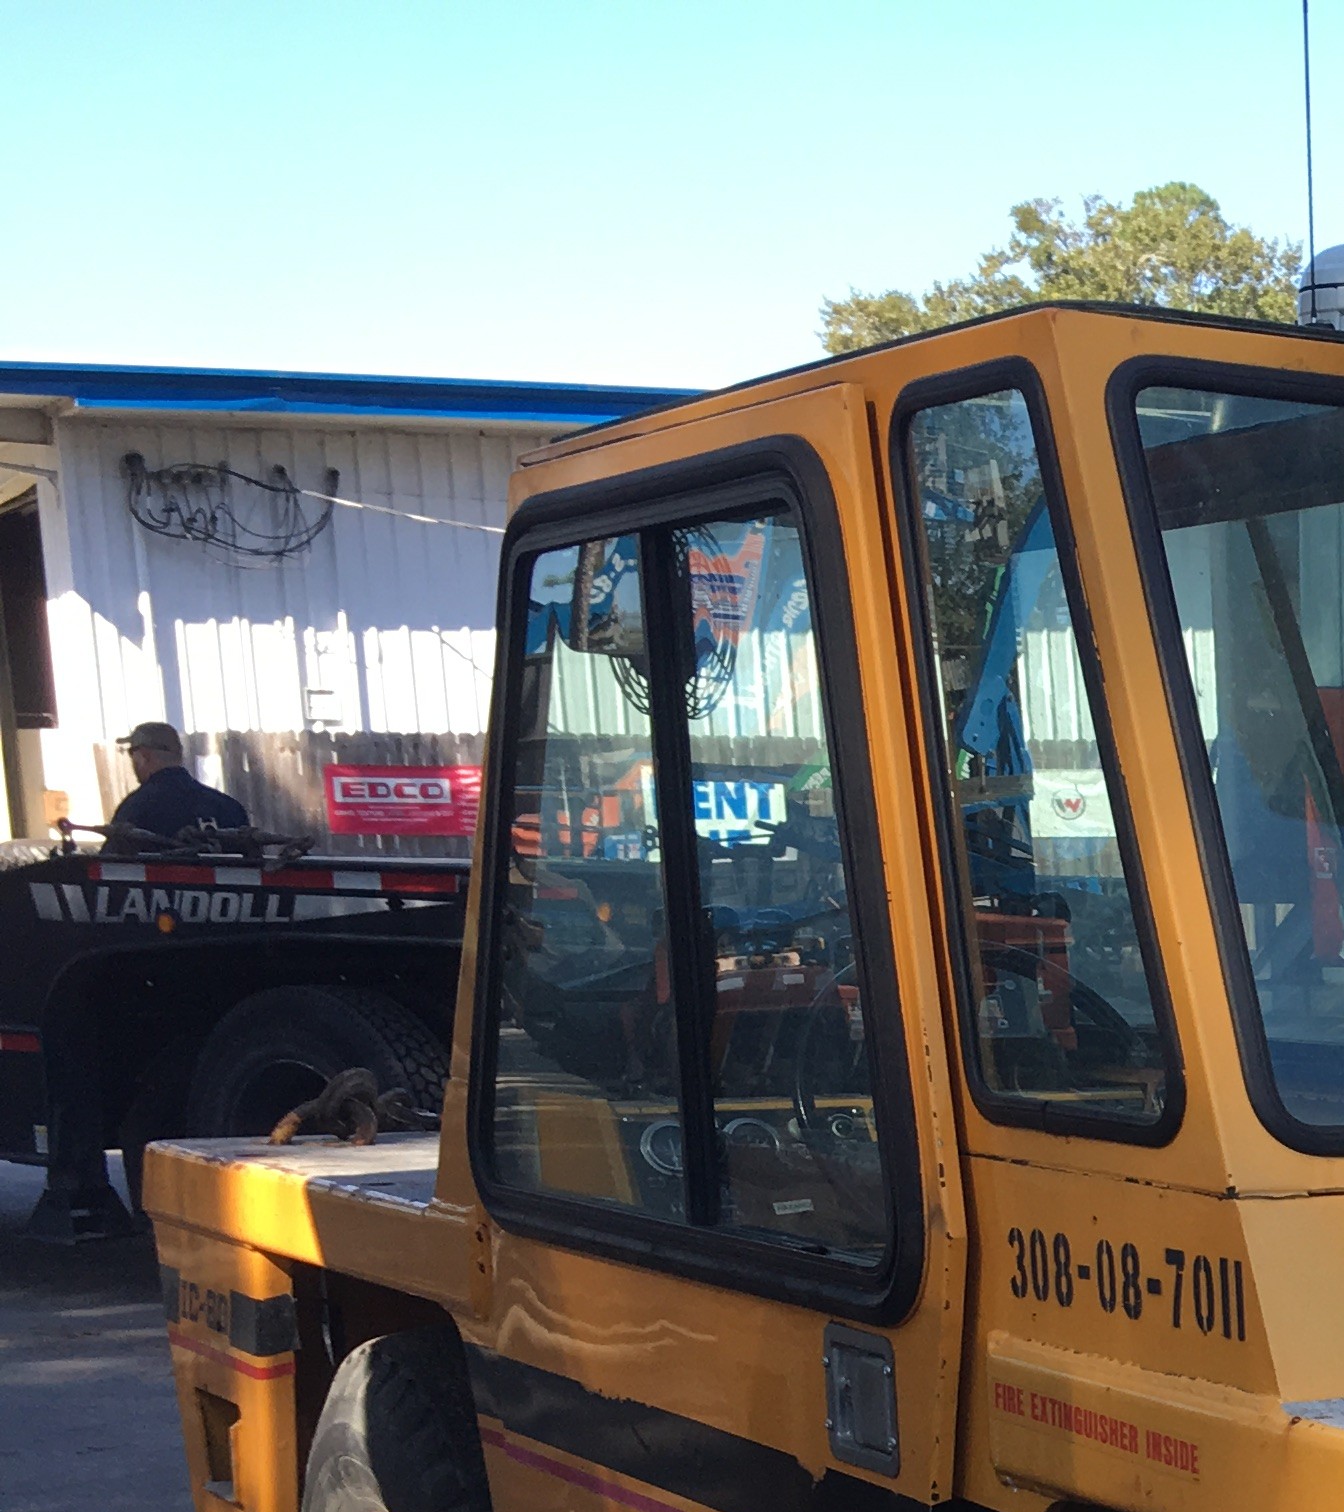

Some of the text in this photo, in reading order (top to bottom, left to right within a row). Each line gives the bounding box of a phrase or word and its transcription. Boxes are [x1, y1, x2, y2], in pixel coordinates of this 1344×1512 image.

[340, 782, 444, 799] EDCO
[652, 779, 776, 820] ENT
[96, 886, 290, 924] LANDOLL
[1008, 1227, 1246, 1342] 308-08-7011
[994, 1382, 1200, 1475] FIRE EXTINGUISHER INSIDE
